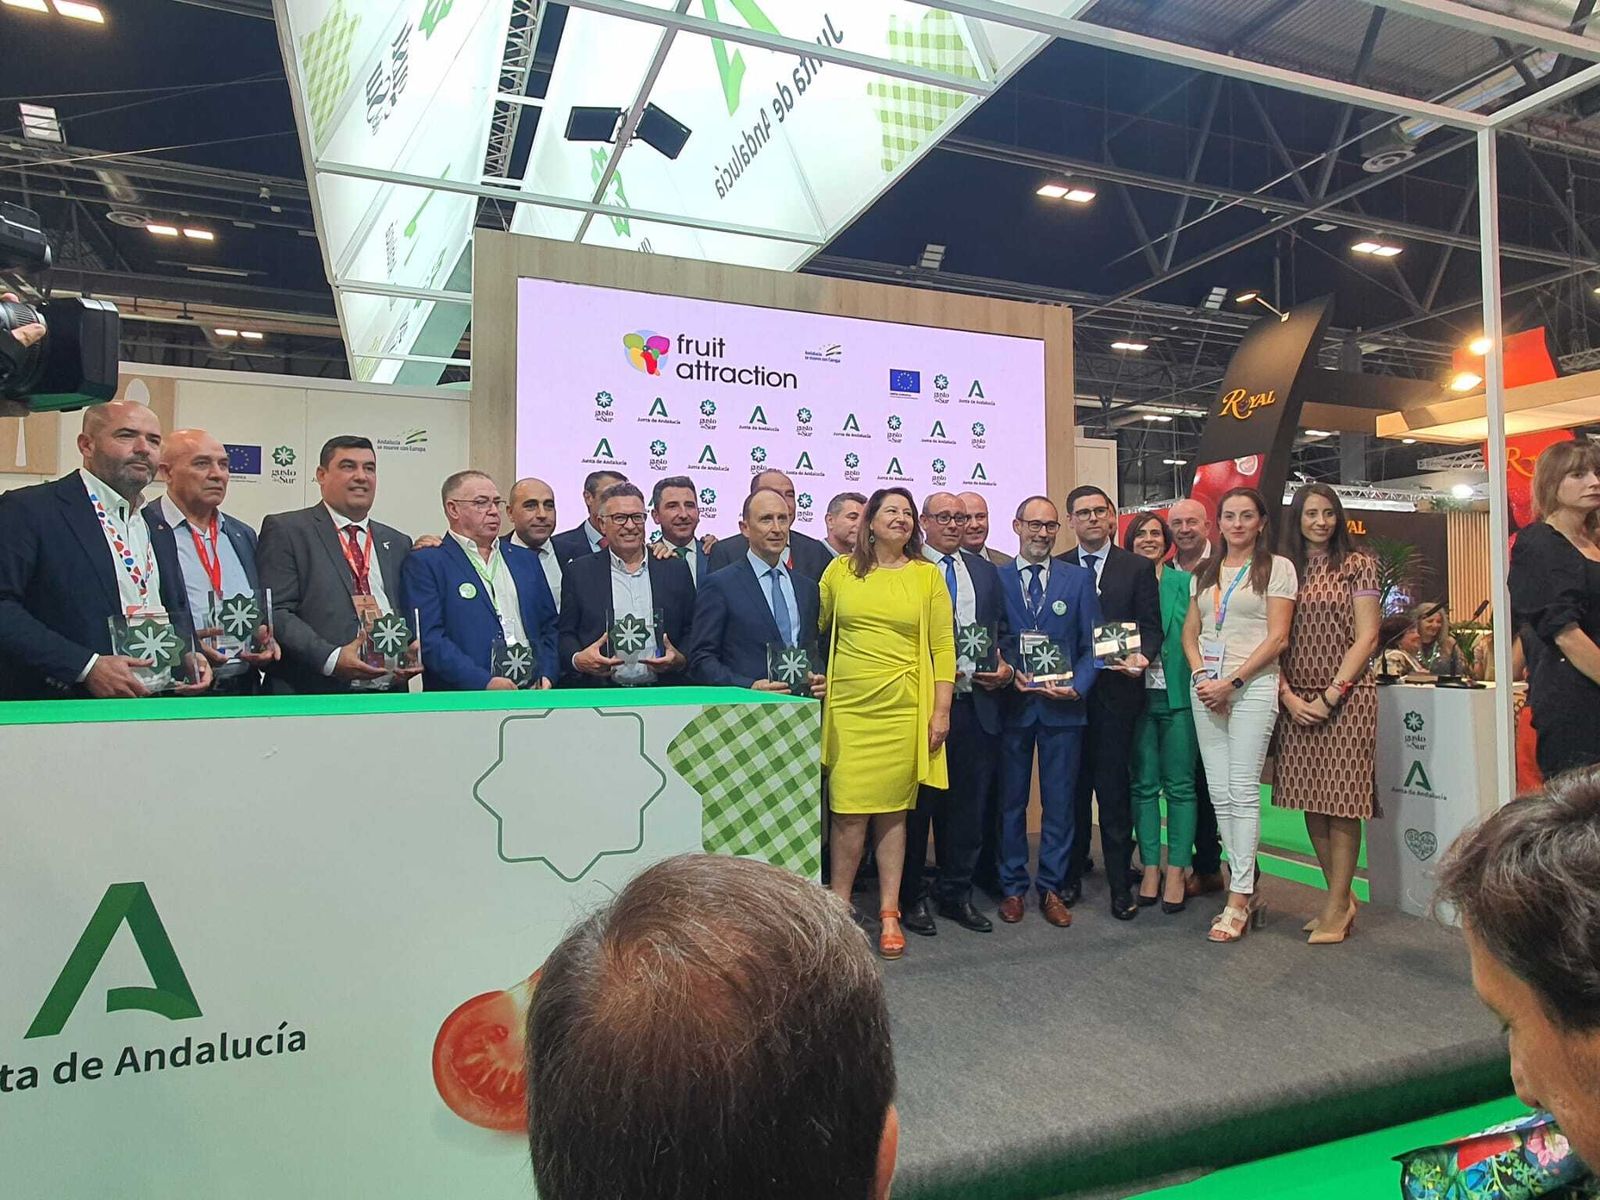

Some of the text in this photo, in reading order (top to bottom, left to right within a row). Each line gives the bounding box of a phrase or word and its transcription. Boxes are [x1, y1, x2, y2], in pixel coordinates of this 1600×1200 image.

[677, 333, 725, 358] fruit
[676, 359, 797, 389] attraction
[52, 1051, 104, 1084] de
[114, 1020, 307, 1077] Andalucía
